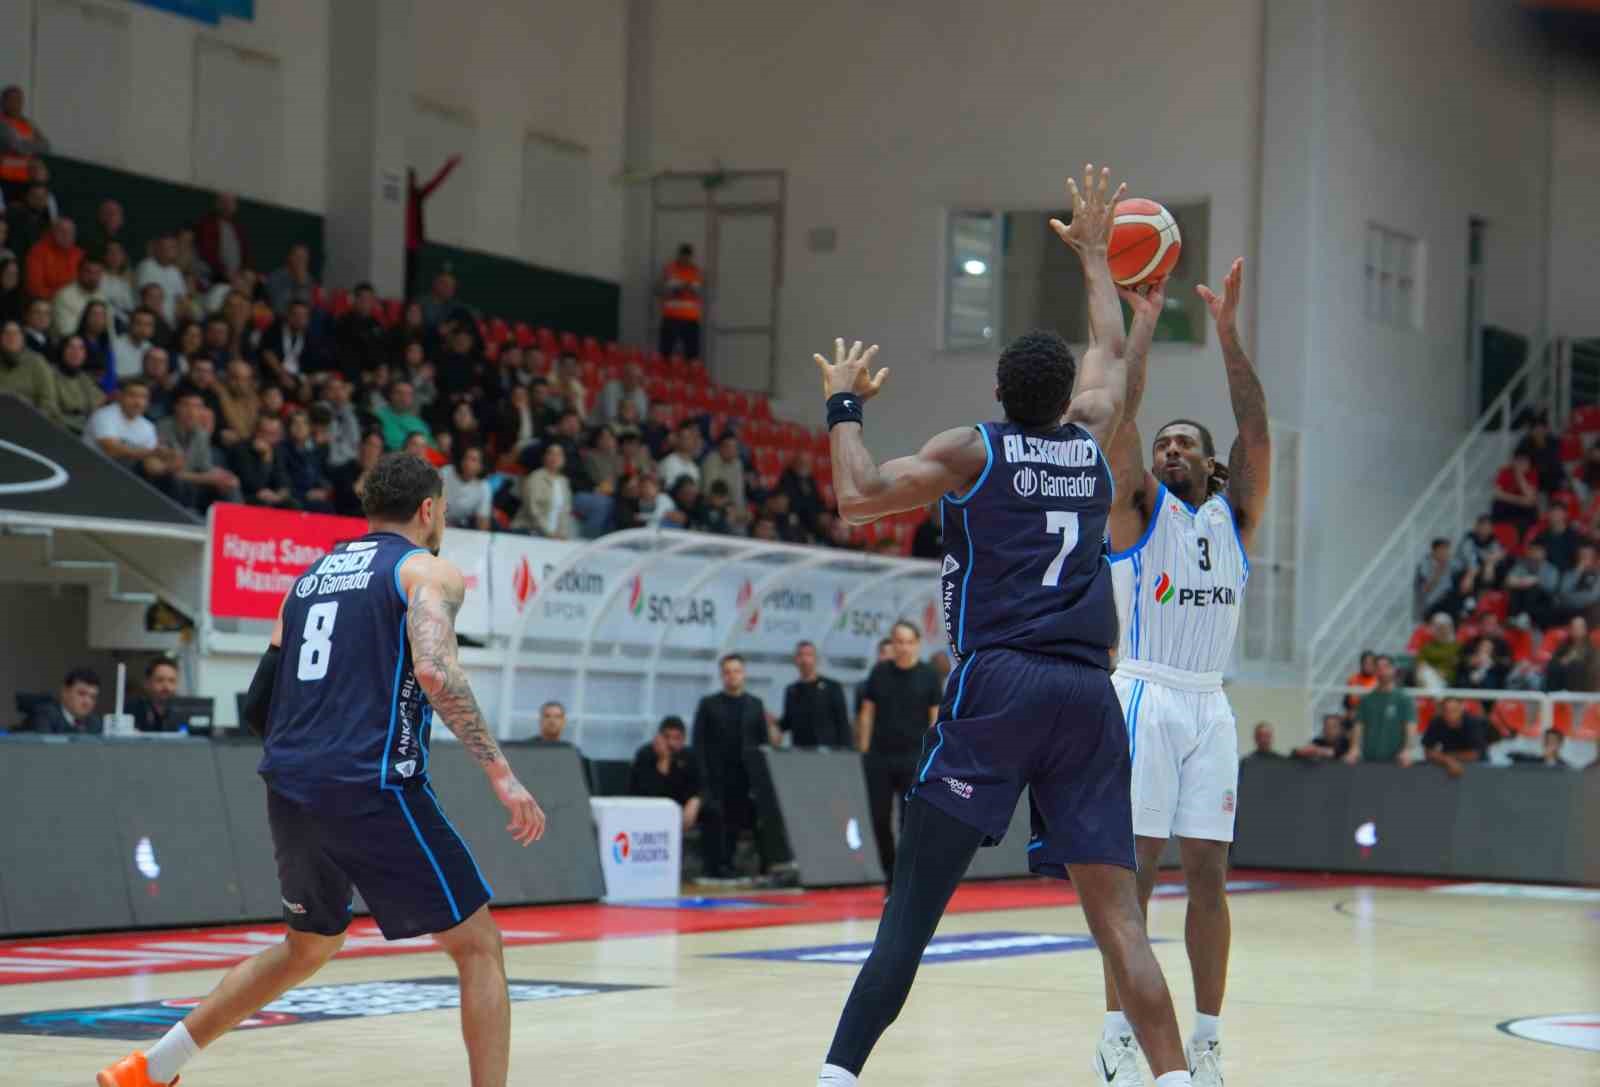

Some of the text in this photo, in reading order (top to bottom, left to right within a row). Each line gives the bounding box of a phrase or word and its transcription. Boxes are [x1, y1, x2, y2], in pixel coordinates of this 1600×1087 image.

[1040, 470, 1097, 497] Gamador
[223, 533, 275, 568] Hayat
[1041, 511, 1079, 587] 7
[1197, 537, 1211, 571] 3
[318, 569, 374, 595] Gamador
[297, 601, 339, 681] 8
